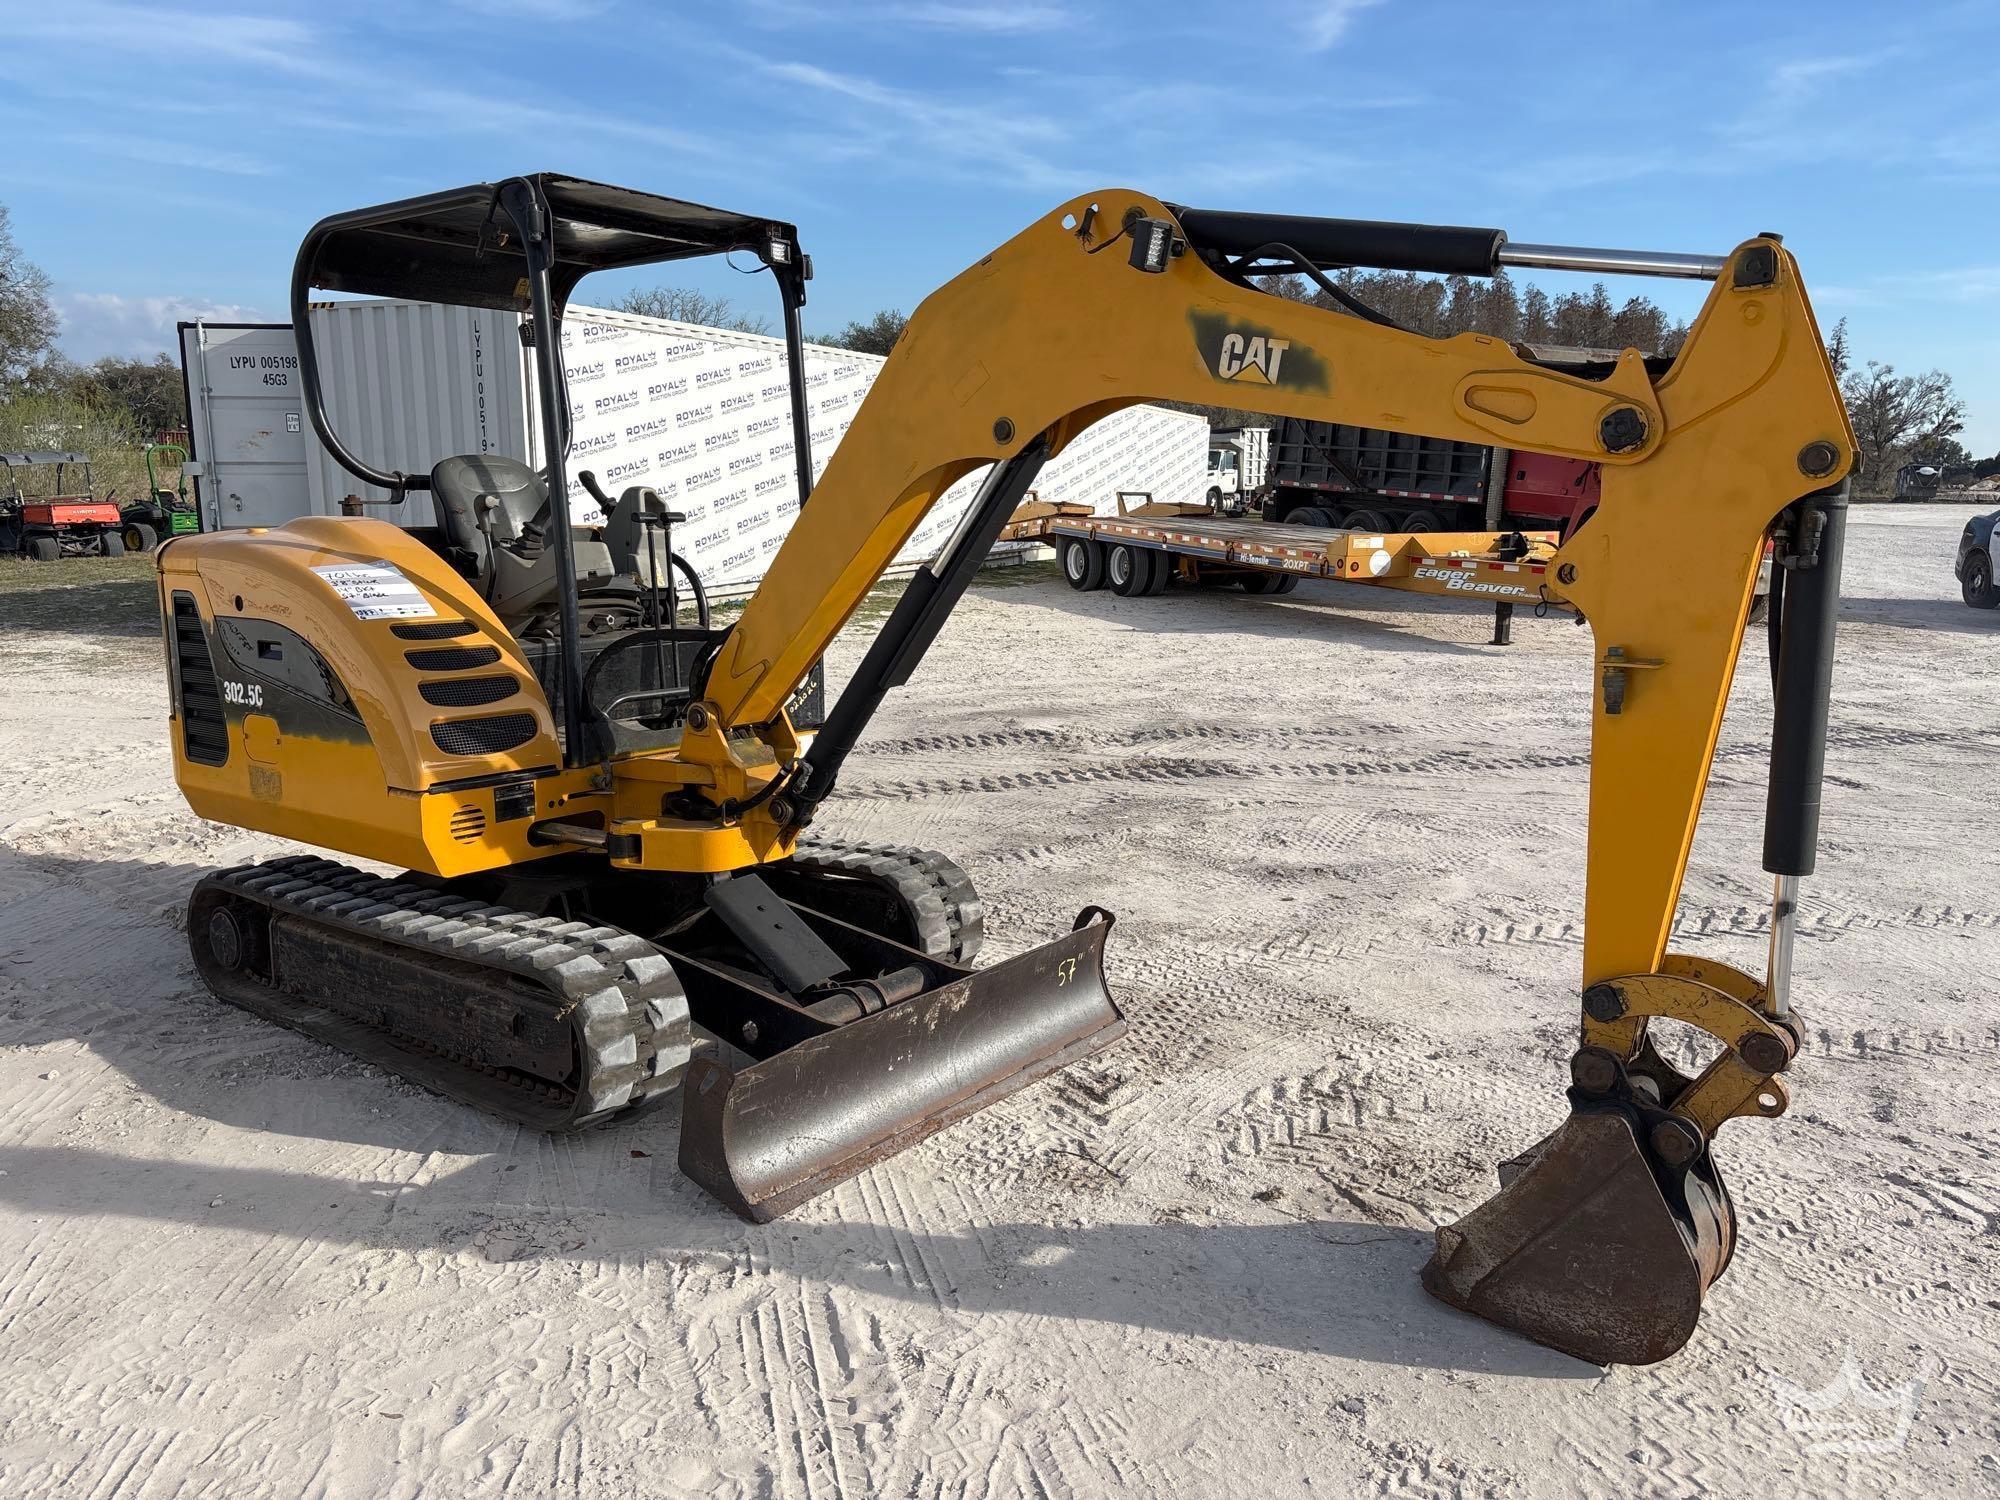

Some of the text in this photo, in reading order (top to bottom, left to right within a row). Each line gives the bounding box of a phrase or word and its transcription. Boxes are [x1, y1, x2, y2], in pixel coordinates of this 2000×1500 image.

[666, 343, 697, 356] ROYAL
[230, 356, 298, 369] LYPU 005198
[615, 353, 648, 368] ROYAL
[739, 359, 765, 372] ROYAL
[1219, 333, 1289, 385] CAT
[567, 364, 595, 378] OYAL
[696, 368, 723, 383] ROYAL
[834, 364, 854, 376] ROYAL
[262, 373, 288, 386] 45G3
[474, 319, 488, 455] LYPU 00519
[804, 374, 822, 385] OYAL
[648, 380, 679, 395] ROYAL
[762, 384, 787, 397] ROYAL
[854, 388, 867, 398] ROY
[595, 393, 629, 409] ROYAL
[720, 395, 747, 409] ROYAL
[821, 396, 842, 409] ROYAL
[676, 408, 705, 422] ROYAL
[626, 421, 658, 436] ROYAL
[747, 418, 772, 433] ROYAL
[705, 432, 732, 446] ROYAL
[811, 430, 829, 441] OYAL
[571, 436, 607, 452] ROYAL
[770, 441, 794, 456] ROYAL
[658, 446, 689, 462] ROYAL
[607, 461, 640, 478] ROYAL
[729, 456, 755, 471] ROYAL
[686, 469, 714, 486] ROYAL
[755, 477, 779, 492] ROYAL
[713, 493, 740, 508] ROYAL
[737, 515, 762, 530] ROYAL
[695, 531, 722, 548] ROYAL
[723, 552, 748, 568] ROYAL
[1240, 553, 1309, 572] Hi-Tensile 20XPT
[1413, 567, 1476, 580] Eager
[1445, 579, 1526, 595] Beaver
[223, 681, 263, 706] 302.5C
[790, 680, 817, 713] 022026
